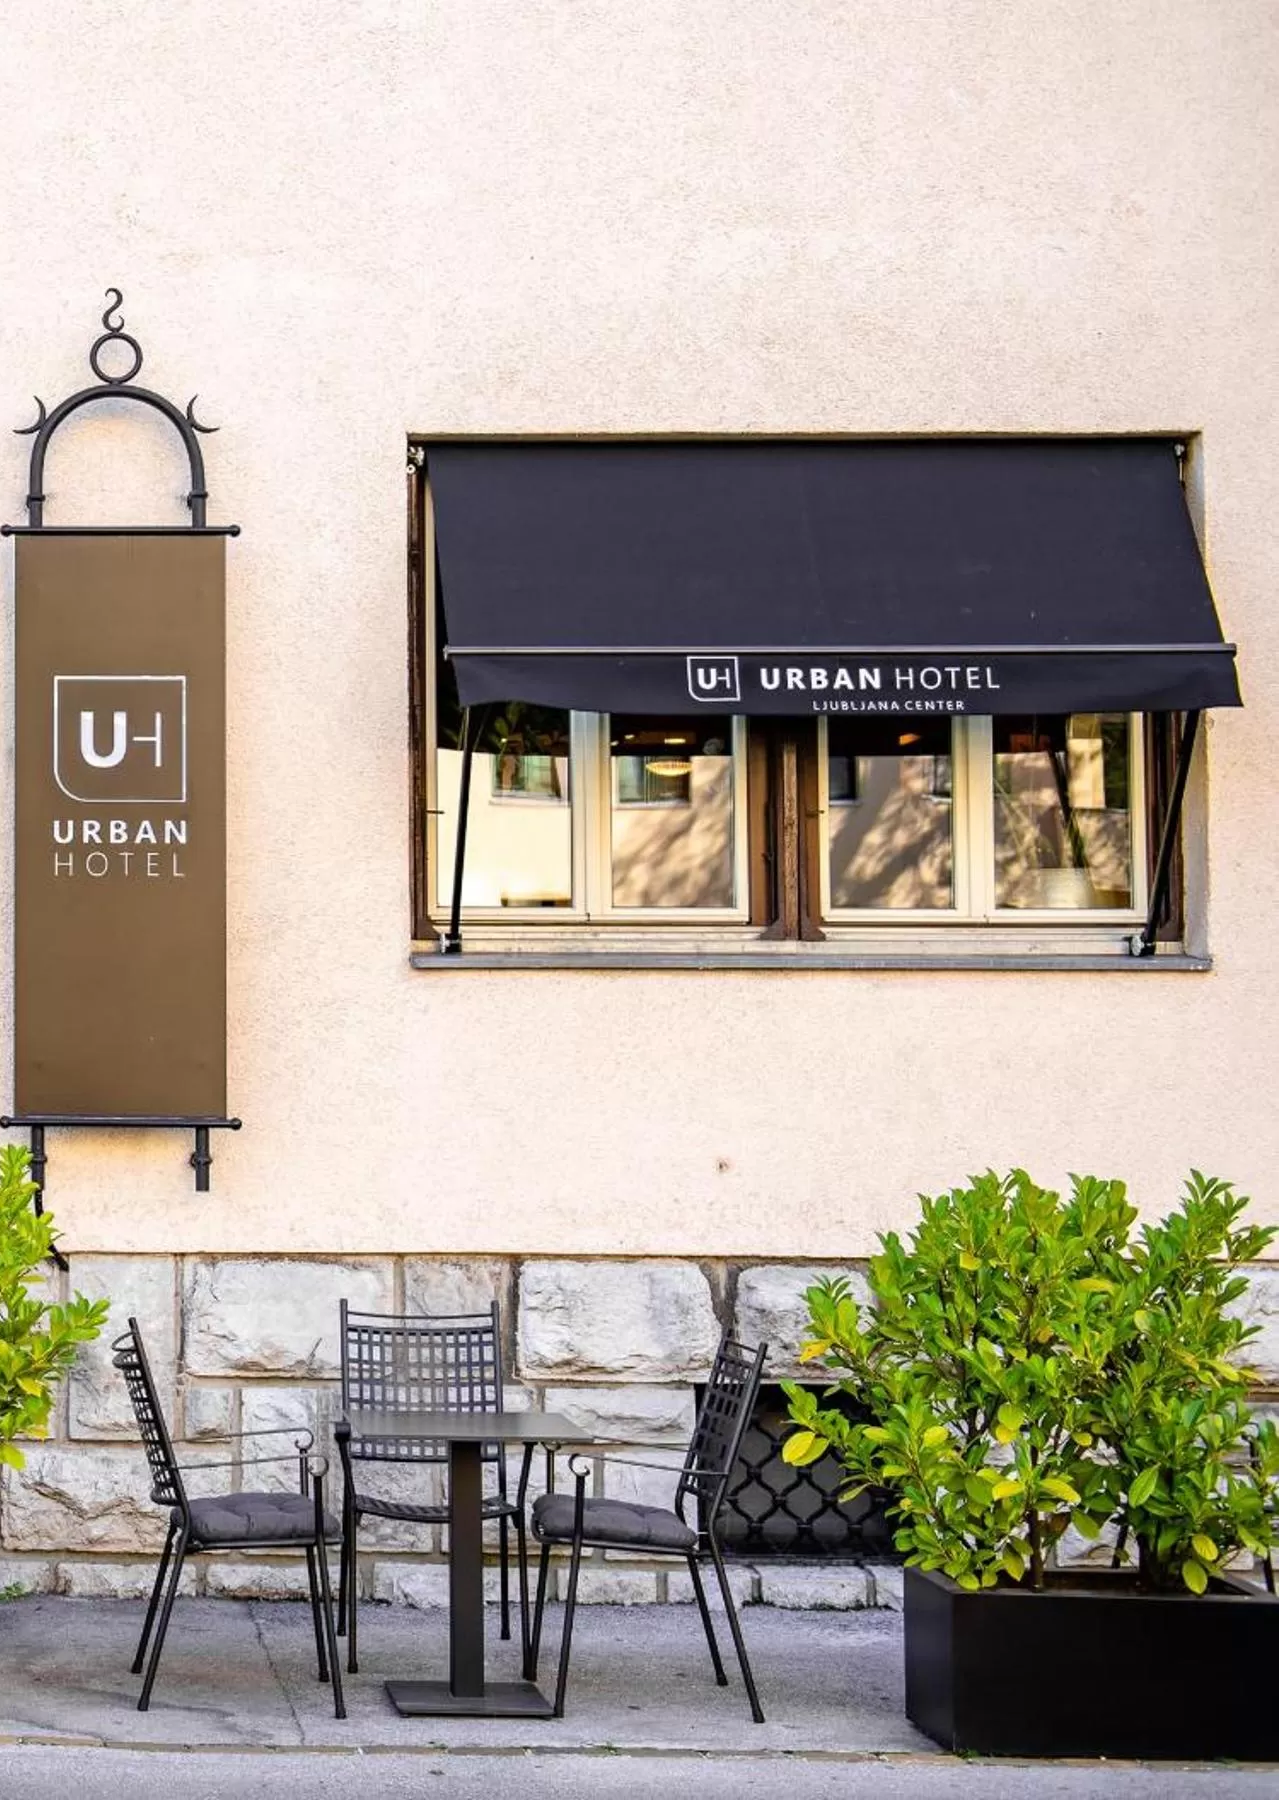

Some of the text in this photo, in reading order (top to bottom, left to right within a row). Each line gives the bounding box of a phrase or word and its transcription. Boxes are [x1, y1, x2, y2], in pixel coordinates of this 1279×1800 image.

[759, 666, 1001, 690] URBAN HOTEL
[812, 700, 965, 711] LJUBLJANA CENTER
[52, 819, 188, 844] URBAN
[53, 852, 187, 877] HOTEL
